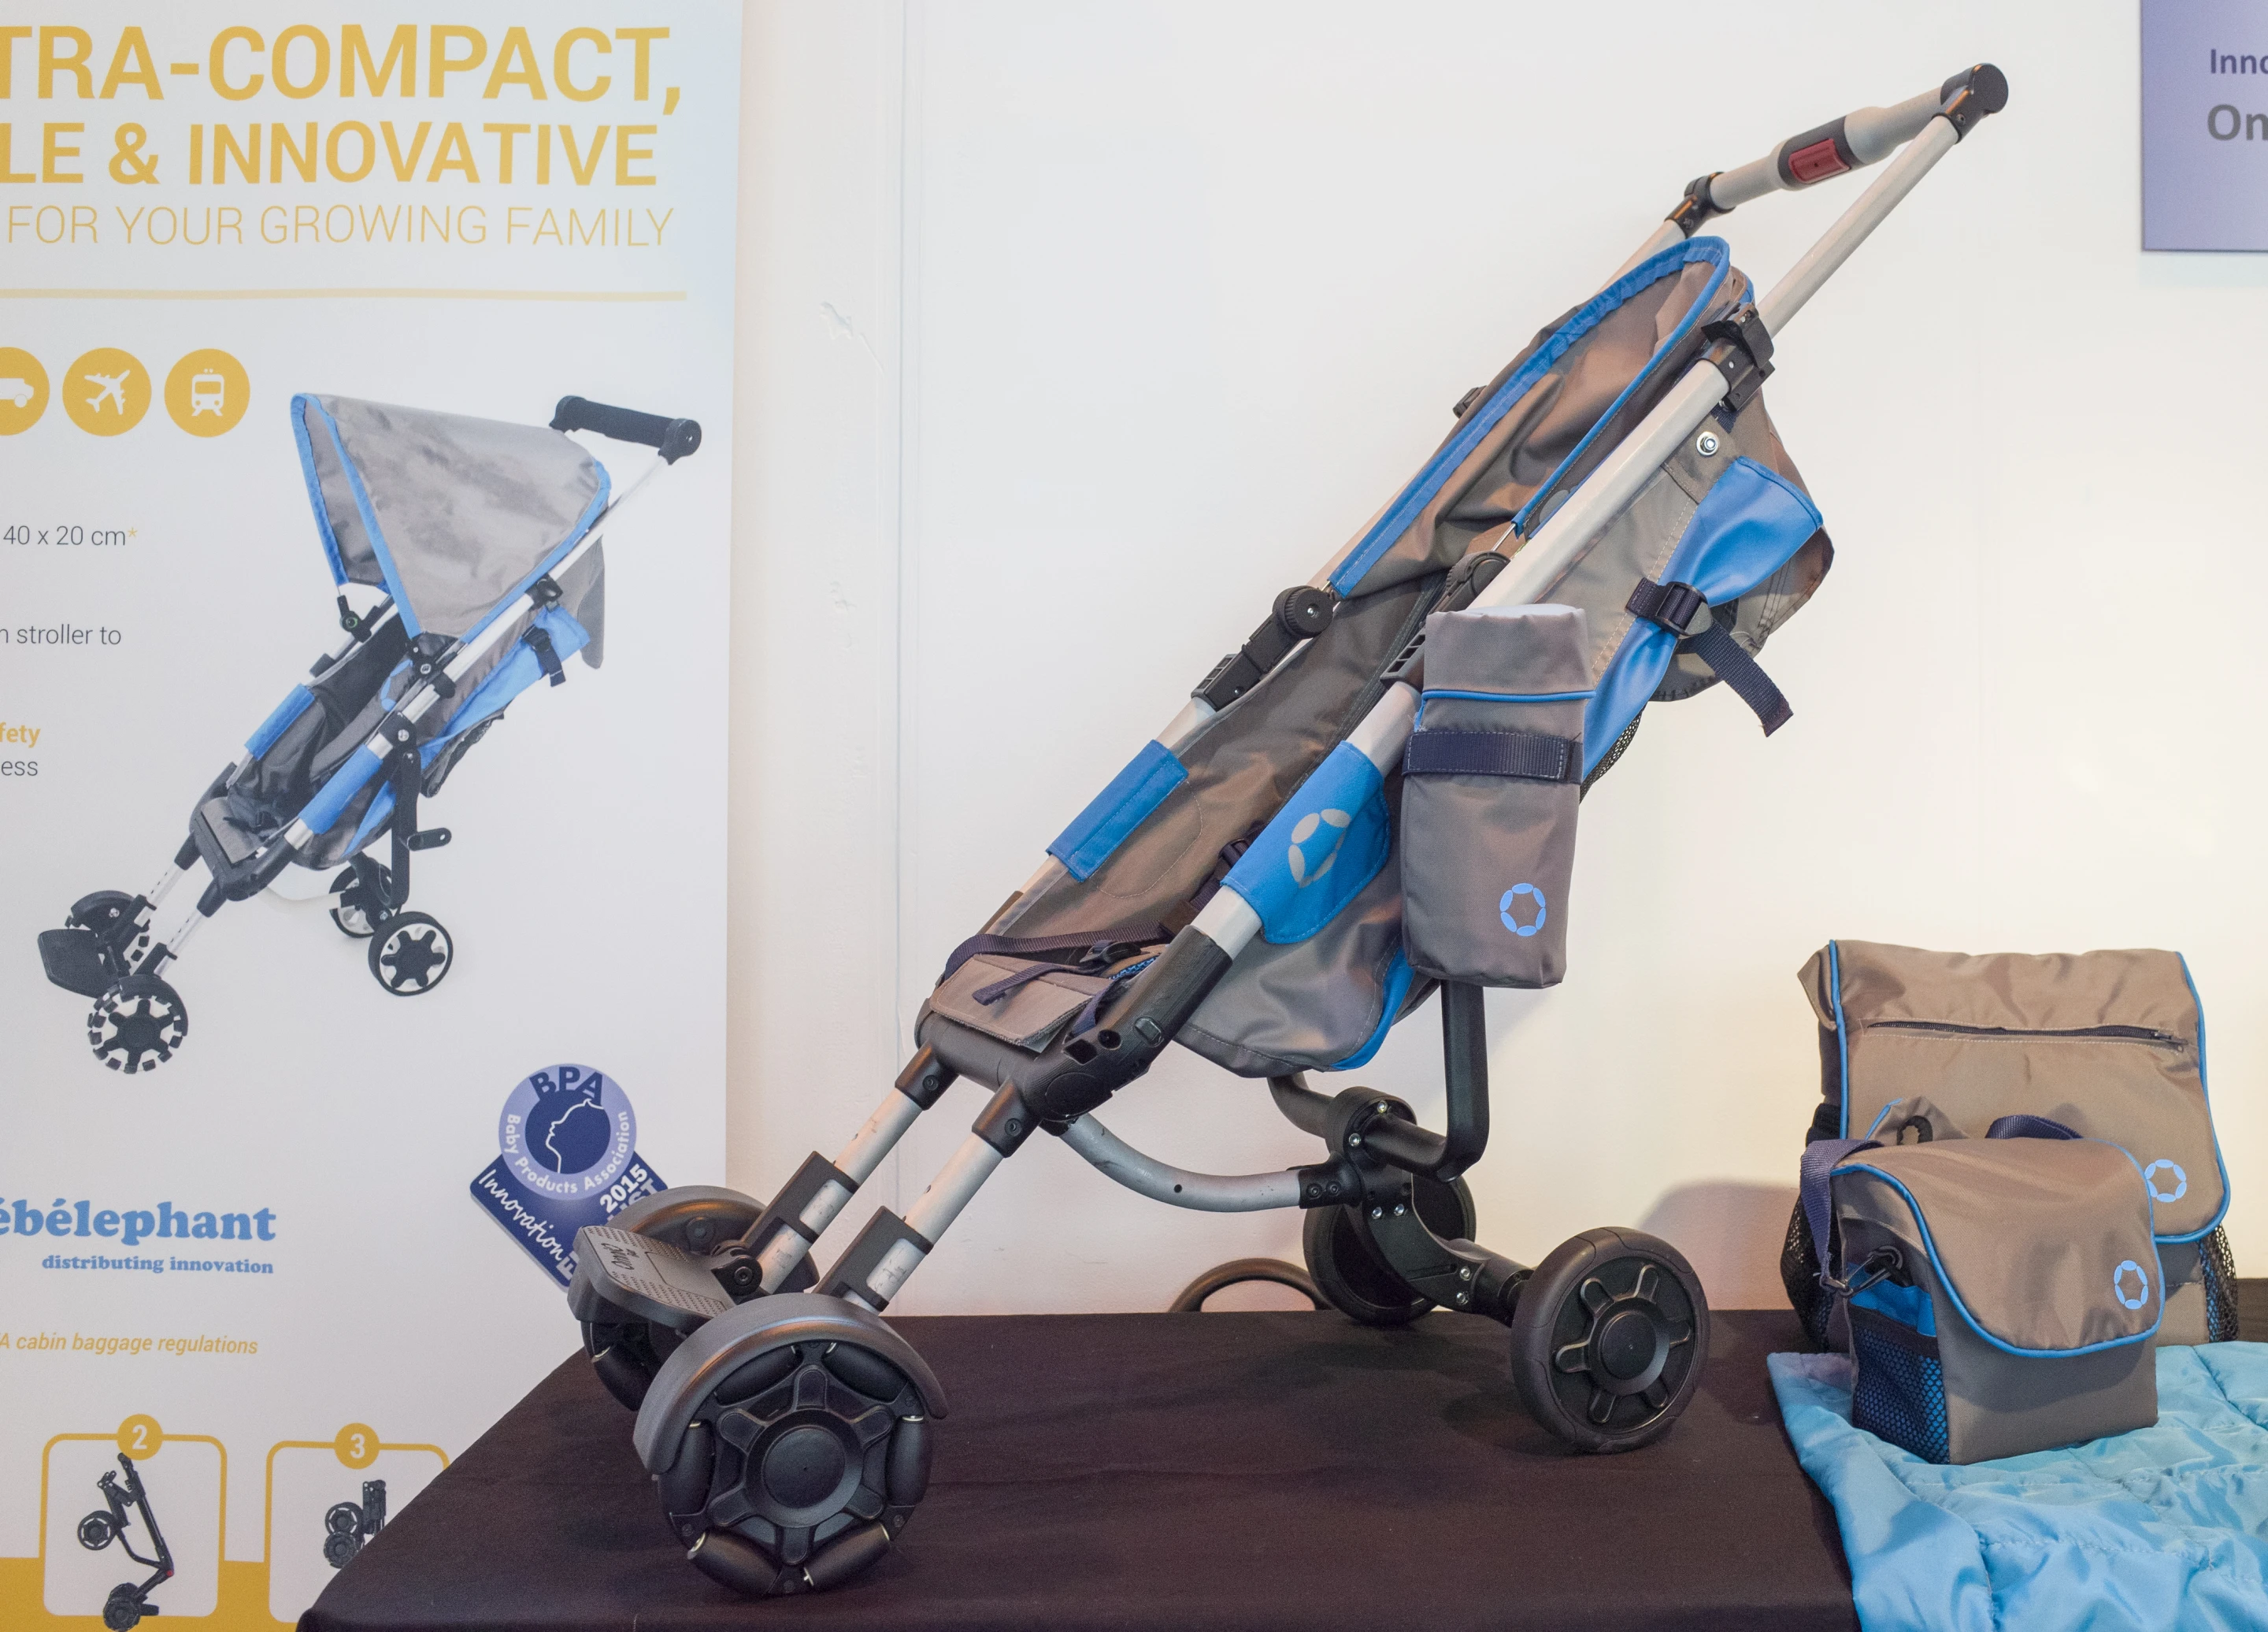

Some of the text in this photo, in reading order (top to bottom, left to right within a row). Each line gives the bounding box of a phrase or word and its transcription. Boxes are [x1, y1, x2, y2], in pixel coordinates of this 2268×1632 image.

[0, 24, 682, 117] TRA-COMPACT,
[0, 121, 659, 187] LE & INNOVATIVE
[9, 205, 674, 247] FOR YOUR GROWING FAMILY
[3, 525, 30, 546] 40
[37, 530, 50, 546] x
[57, 526, 84, 547] 20
[17, 624, 93, 646] stroller
[100, 627, 123, 646] to
[2, 761, 39, 777] ess
[528, 1066, 603, 1104] BPA
[504, 1111, 630, 1193] Baby Products Association
[599, 1163, 648, 1214] 2015
[479, 1169, 564, 1261] Innovation
[42, 1255, 274, 1274] distributing innovation
[16, 1332, 67, 1351] cabin
[72, 1332, 154, 1356] baggage
[157, 1334, 258, 1357] regulations
[132, 1424, 149, 1450] 2
[349, 1433, 366, 1459] 3
